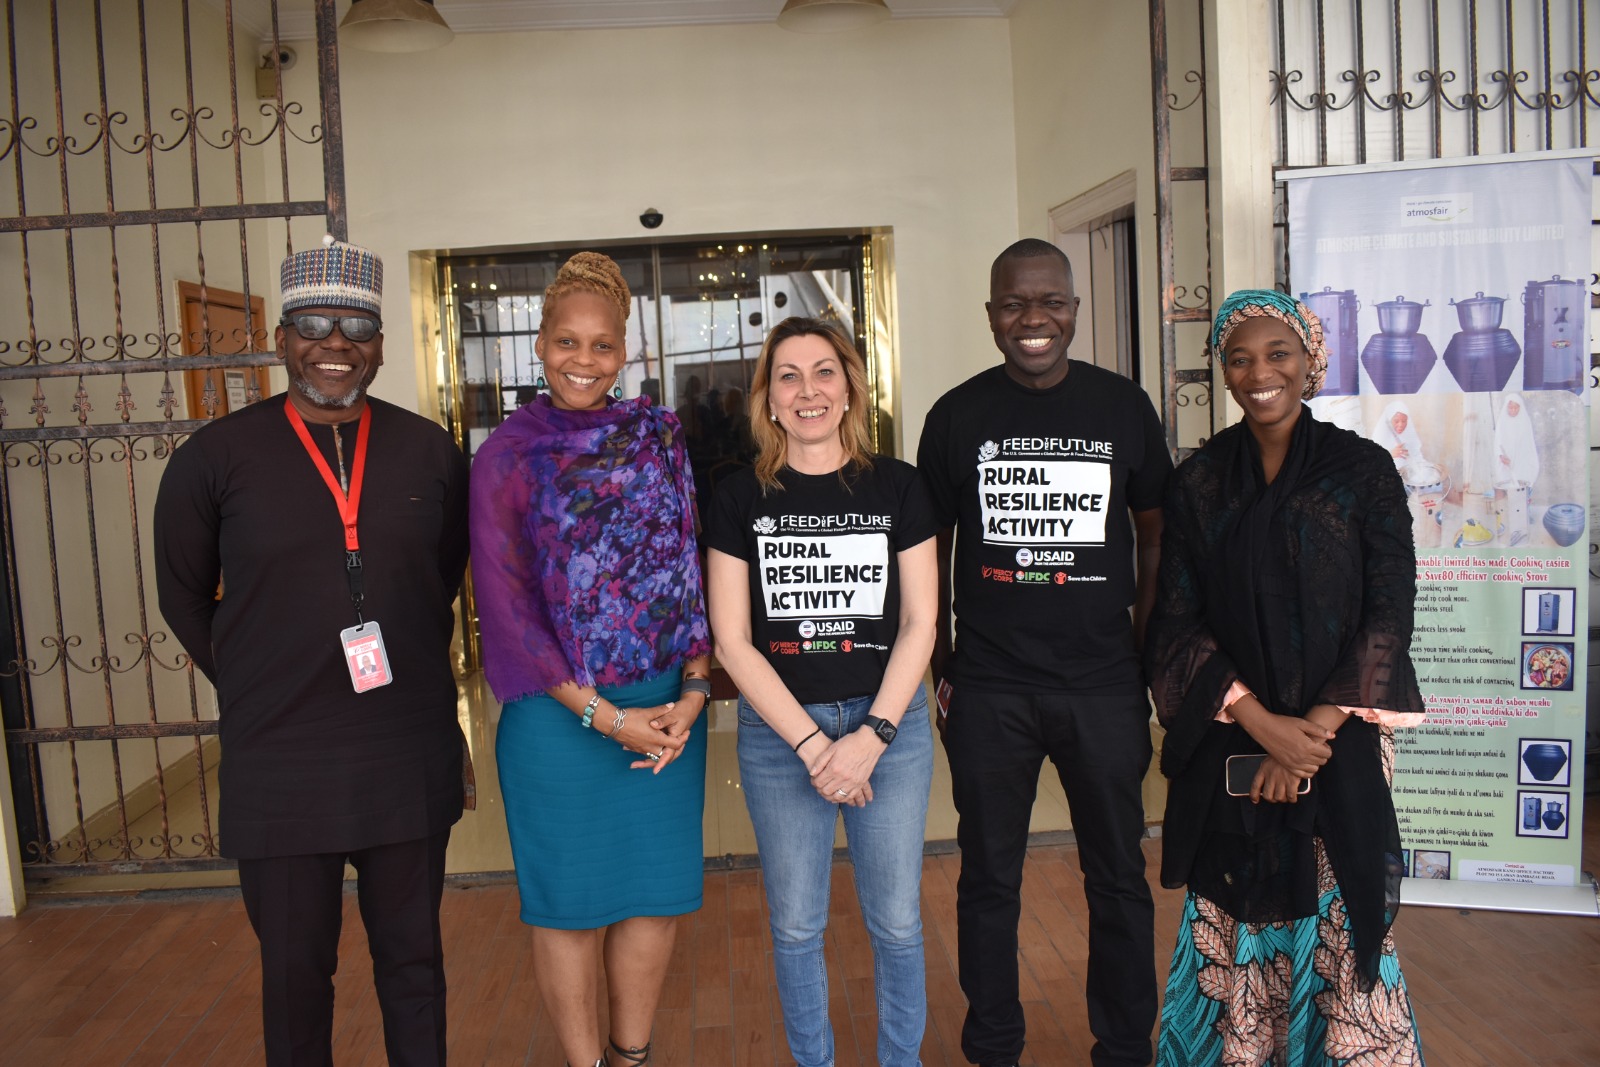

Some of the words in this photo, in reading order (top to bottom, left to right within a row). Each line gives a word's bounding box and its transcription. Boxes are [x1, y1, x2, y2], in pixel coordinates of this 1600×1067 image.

[1407, 206, 1448, 216] atmosfair
[1416, 232, 1437, 248] AND
[1523, 224, 1565, 242] LIMITED
[1003, 438, 1044, 450] FEED
[1050, 438, 1112, 454] FUTURE
[984, 468, 1050, 486] RURAL
[985, 493, 1103, 512] RESILIENCE
[781, 515, 820, 528] FEED
[827, 513, 892, 526] FUTURE
[988, 516, 1074, 536] ACTIVITY
[764, 542, 832, 560] RURAL
[1034, 550, 1075, 562] USAID
[1415, 557, 1441, 566] ainable
[1510, 557, 1543, 569] Cooking
[766, 565, 883, 585] RESILIENCE
[993, 568, 1014, 576] MERCY
[1025, 572, 1050, 581] IFDC
[1425, 571, 1453, 581] Save80
[1493, 571, 1523, 584] cooking
[1526, 572, 1548, 581] Stove
[993, 575, 1013, 583] CORPS
[771, 590, 855, 610] ACTIVITY
[816, 621, 855, 632] USAID
[813, 641, 837, 650] IFDC
[1452, 706, 1469, 716] (80)
